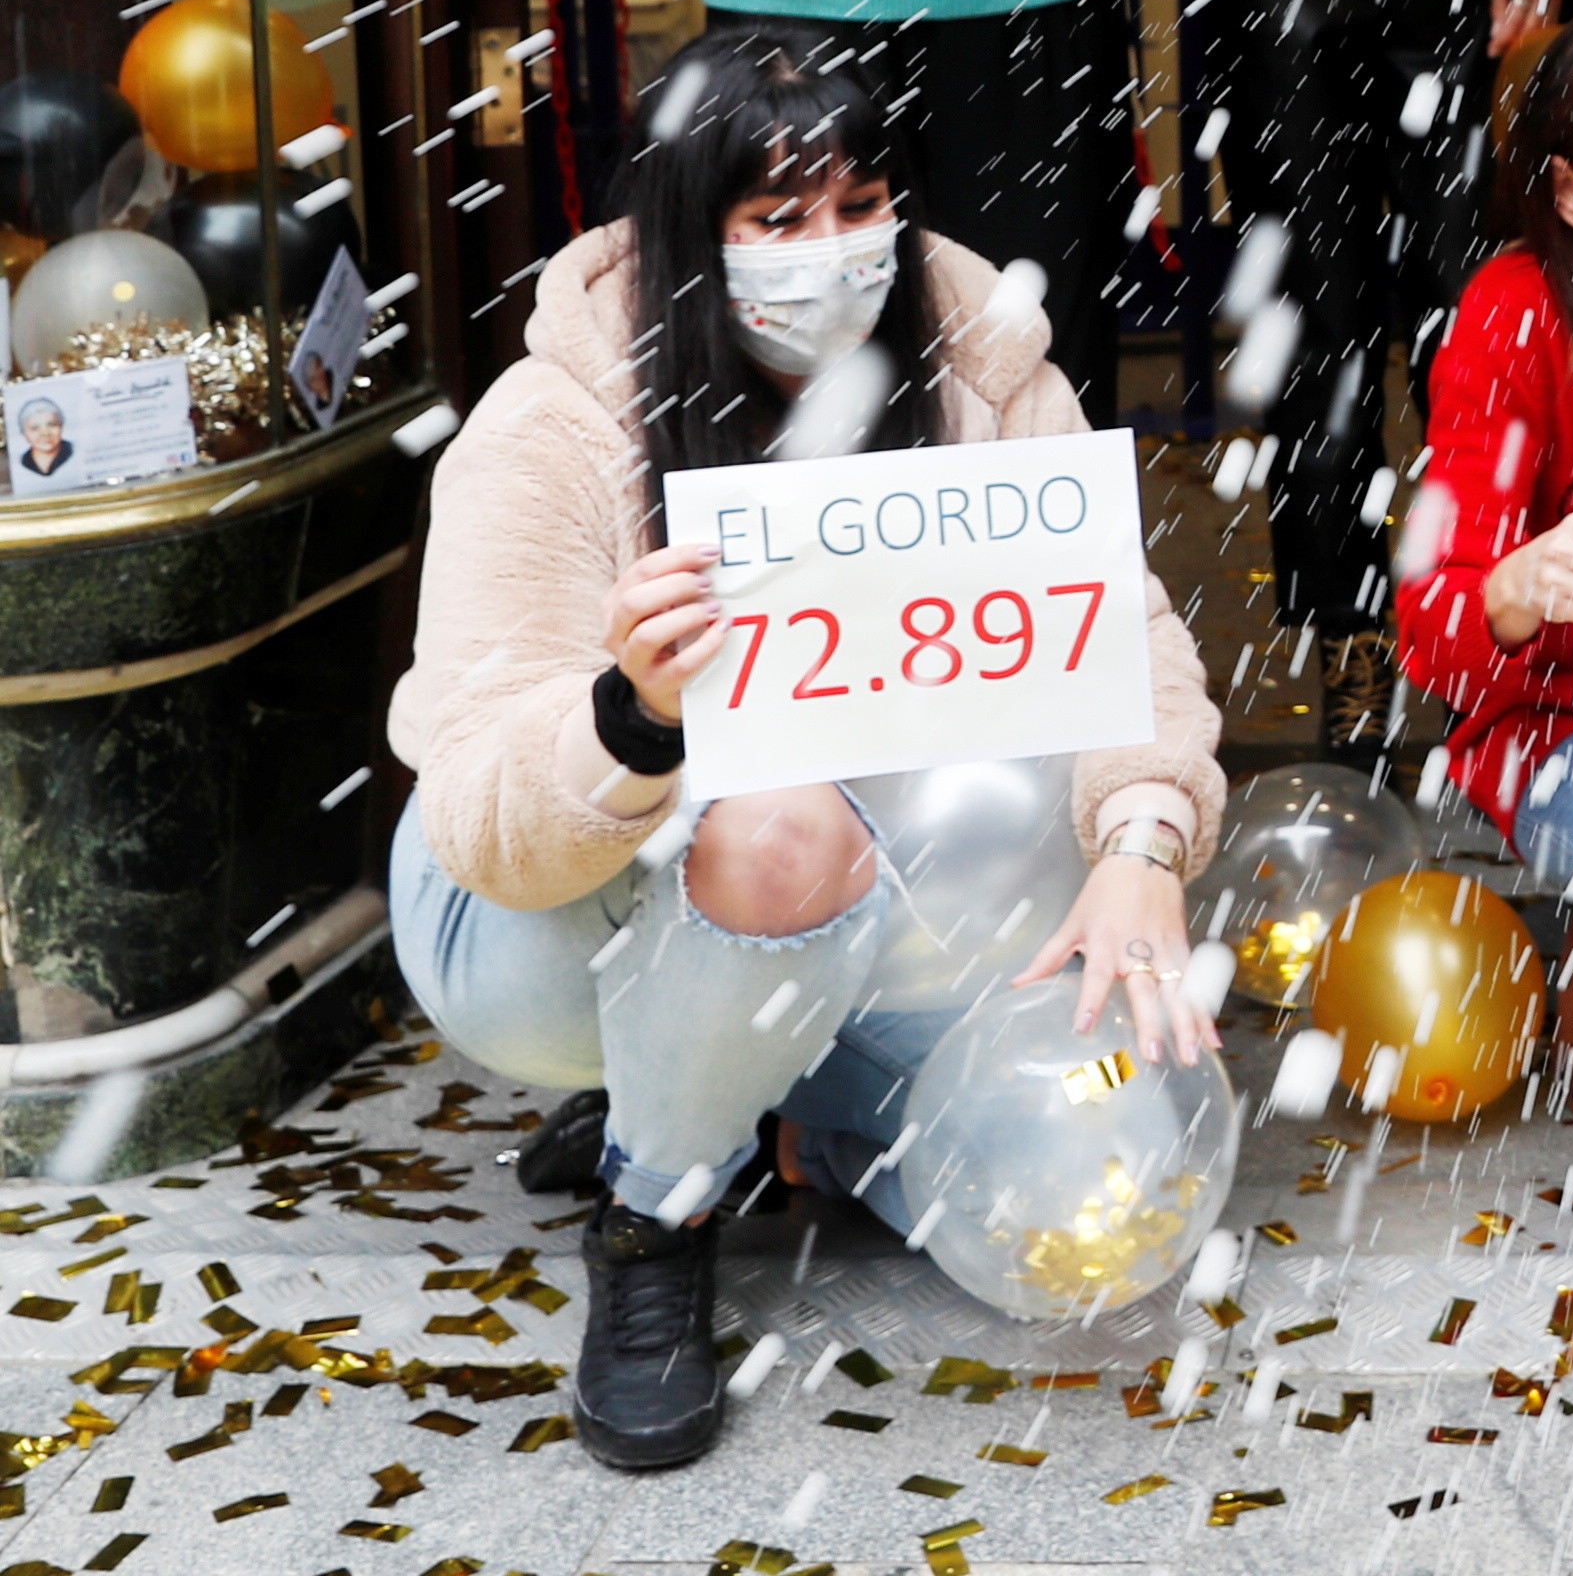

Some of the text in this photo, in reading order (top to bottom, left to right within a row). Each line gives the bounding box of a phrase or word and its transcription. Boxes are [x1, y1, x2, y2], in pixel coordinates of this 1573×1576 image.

[715, 474, 1089, 568] EL GORDO
[722, 580, 1107, 711] 72.897
